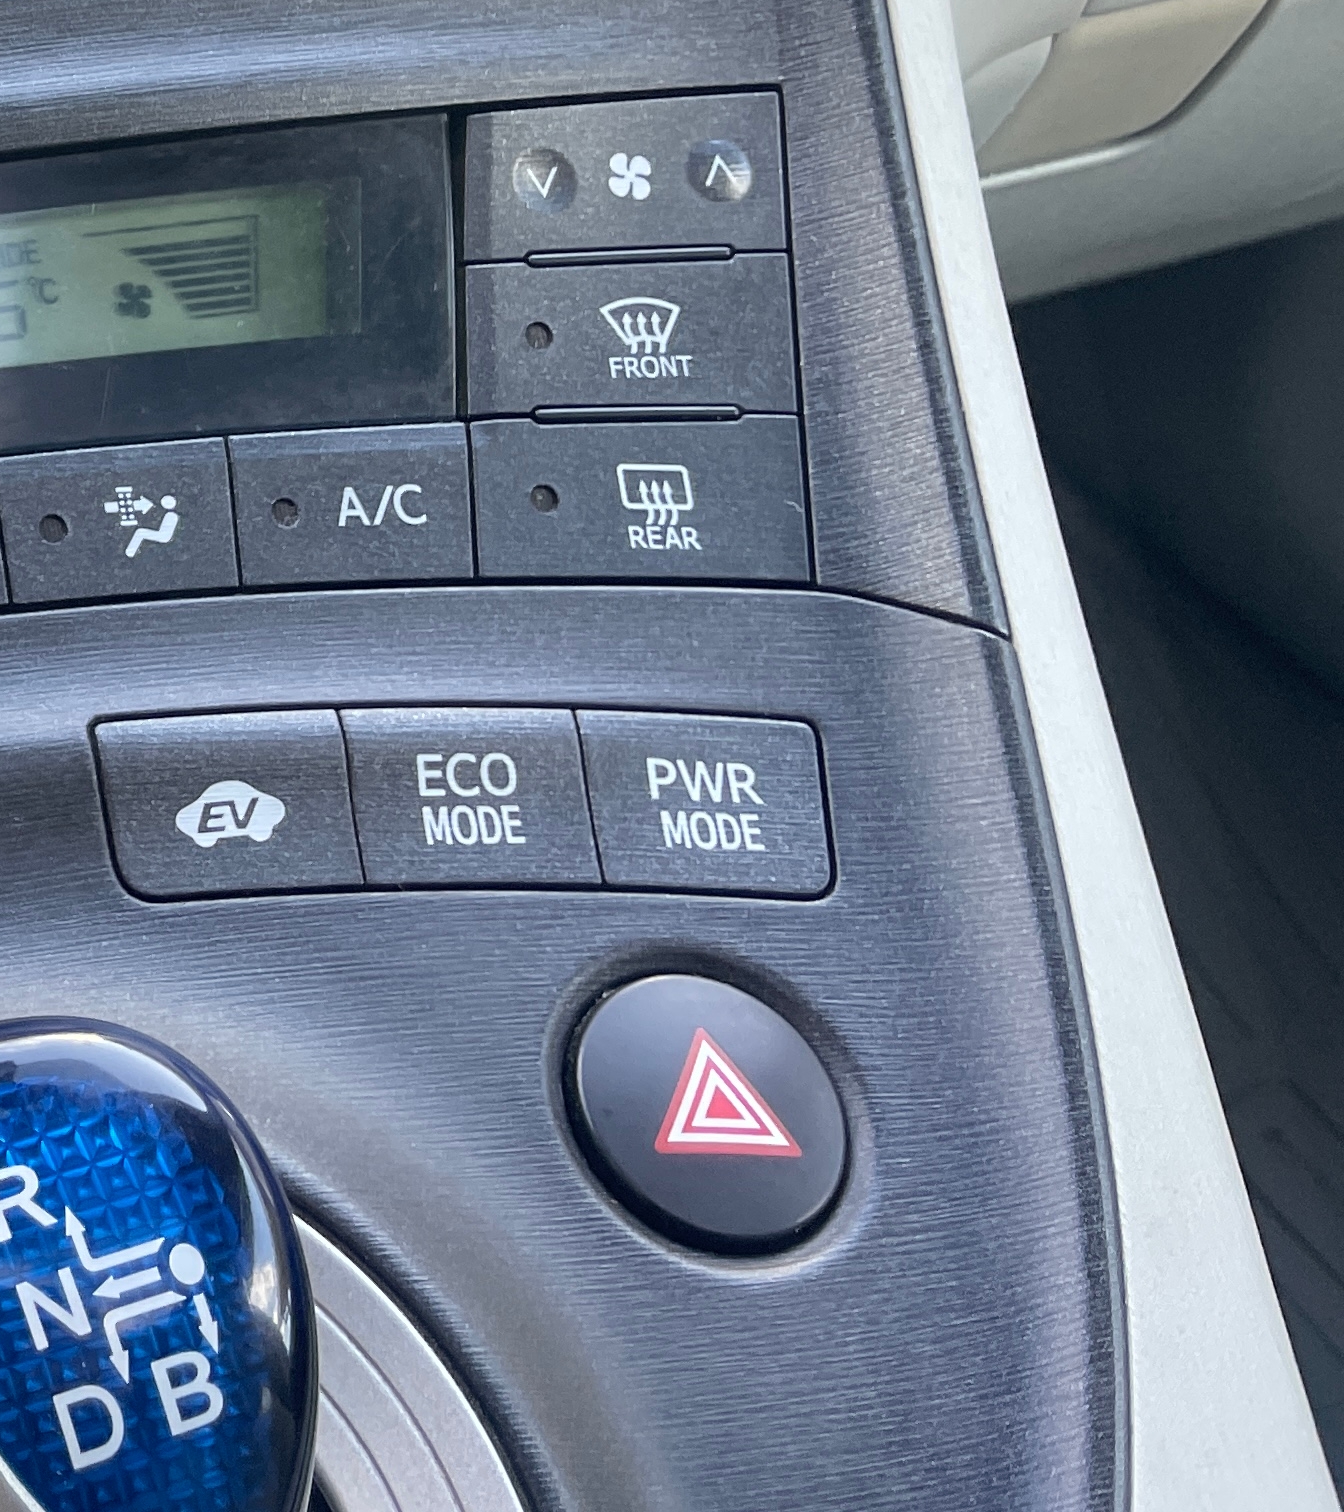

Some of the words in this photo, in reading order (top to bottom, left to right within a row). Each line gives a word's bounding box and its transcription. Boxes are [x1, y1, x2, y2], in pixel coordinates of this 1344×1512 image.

[608, 354, 693, 379] FRONT
[338, 483, 428, 527] A/C
[627, 525, 703, 551] REAR
[416, 752, 518, 797] ECO
[646, 757, 765, 805] PWR
[197, 796, 260, 834] EV
[422, 804, 526, 846] MODE
[660, 809, 767, 853] MODE
[14, 1267, 94, 1352] N
[150, 1350, 225, 1437] B
[52, 1384, 125, 1471] D
